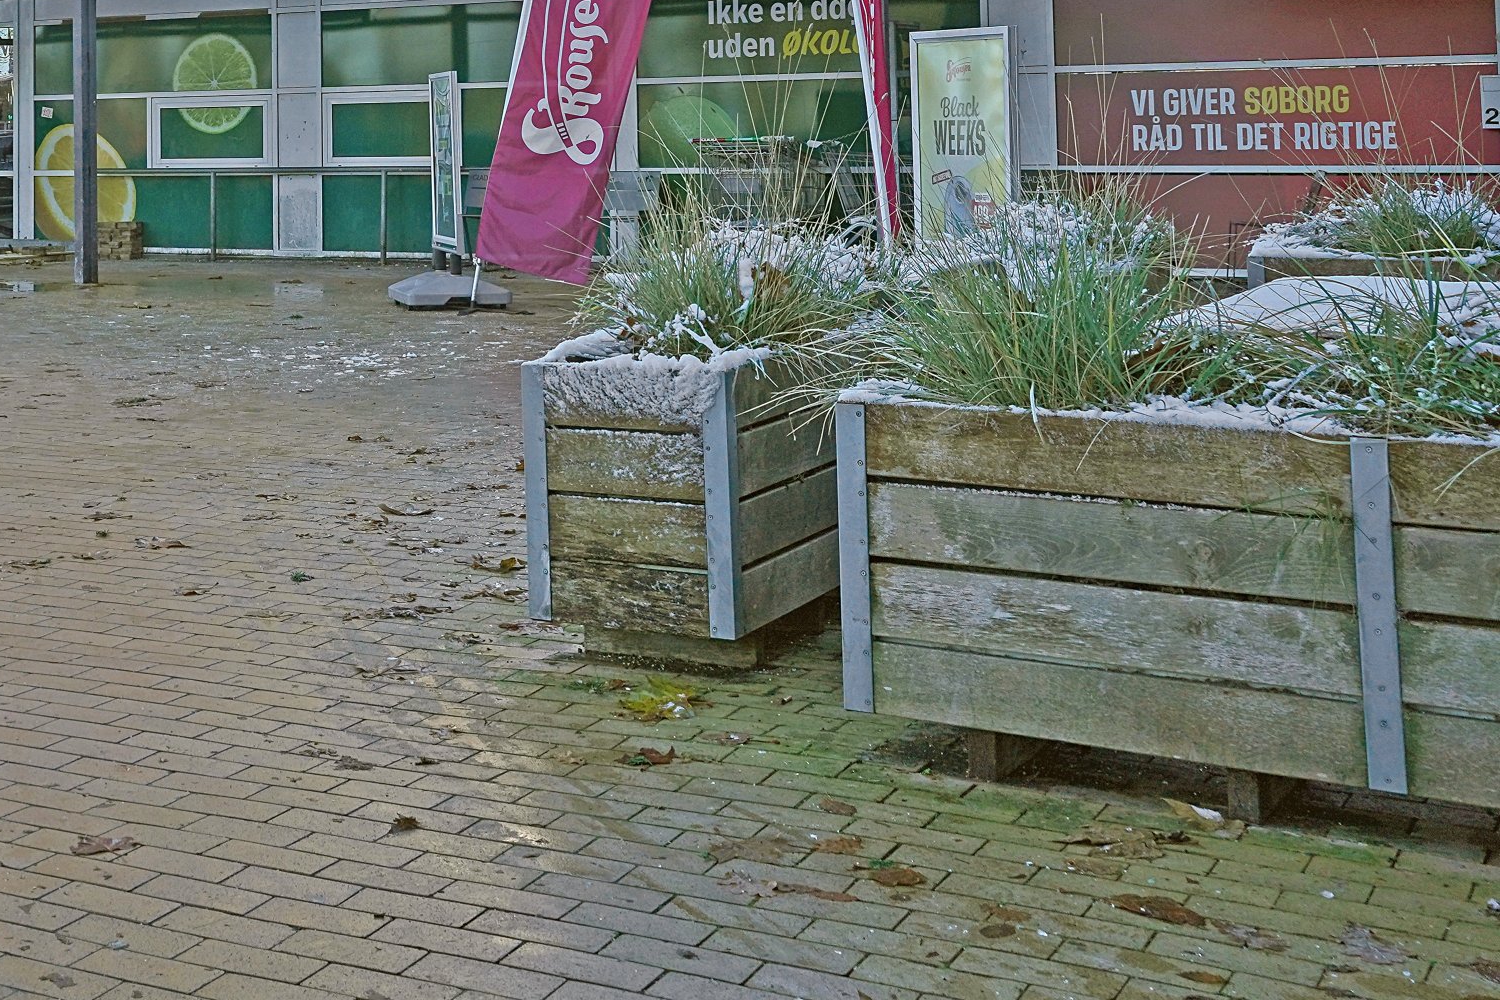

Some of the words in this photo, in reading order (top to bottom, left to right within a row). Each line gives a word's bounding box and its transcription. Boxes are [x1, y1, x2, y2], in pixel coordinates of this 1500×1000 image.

[707, 0, 763, 25] Ikke
[770, 1, 803, 22] en
[708, 33, 775, 59] uden
[940, 95, 981, 118] Black
[1131, 89, 1155, 117] VI
[1163, 87, 1236, 116] GIVER
[1244, 84, 1350, 115] SØBORG
[933, 120, 986, 156] WEEKS
[1132, 115, 1183, 151] RÅD
[1191, 123, 1227, 151] TIL
[1237, 122, 1284, 150] DET
[1294, 120, 1397, 150] RIGTIGE
